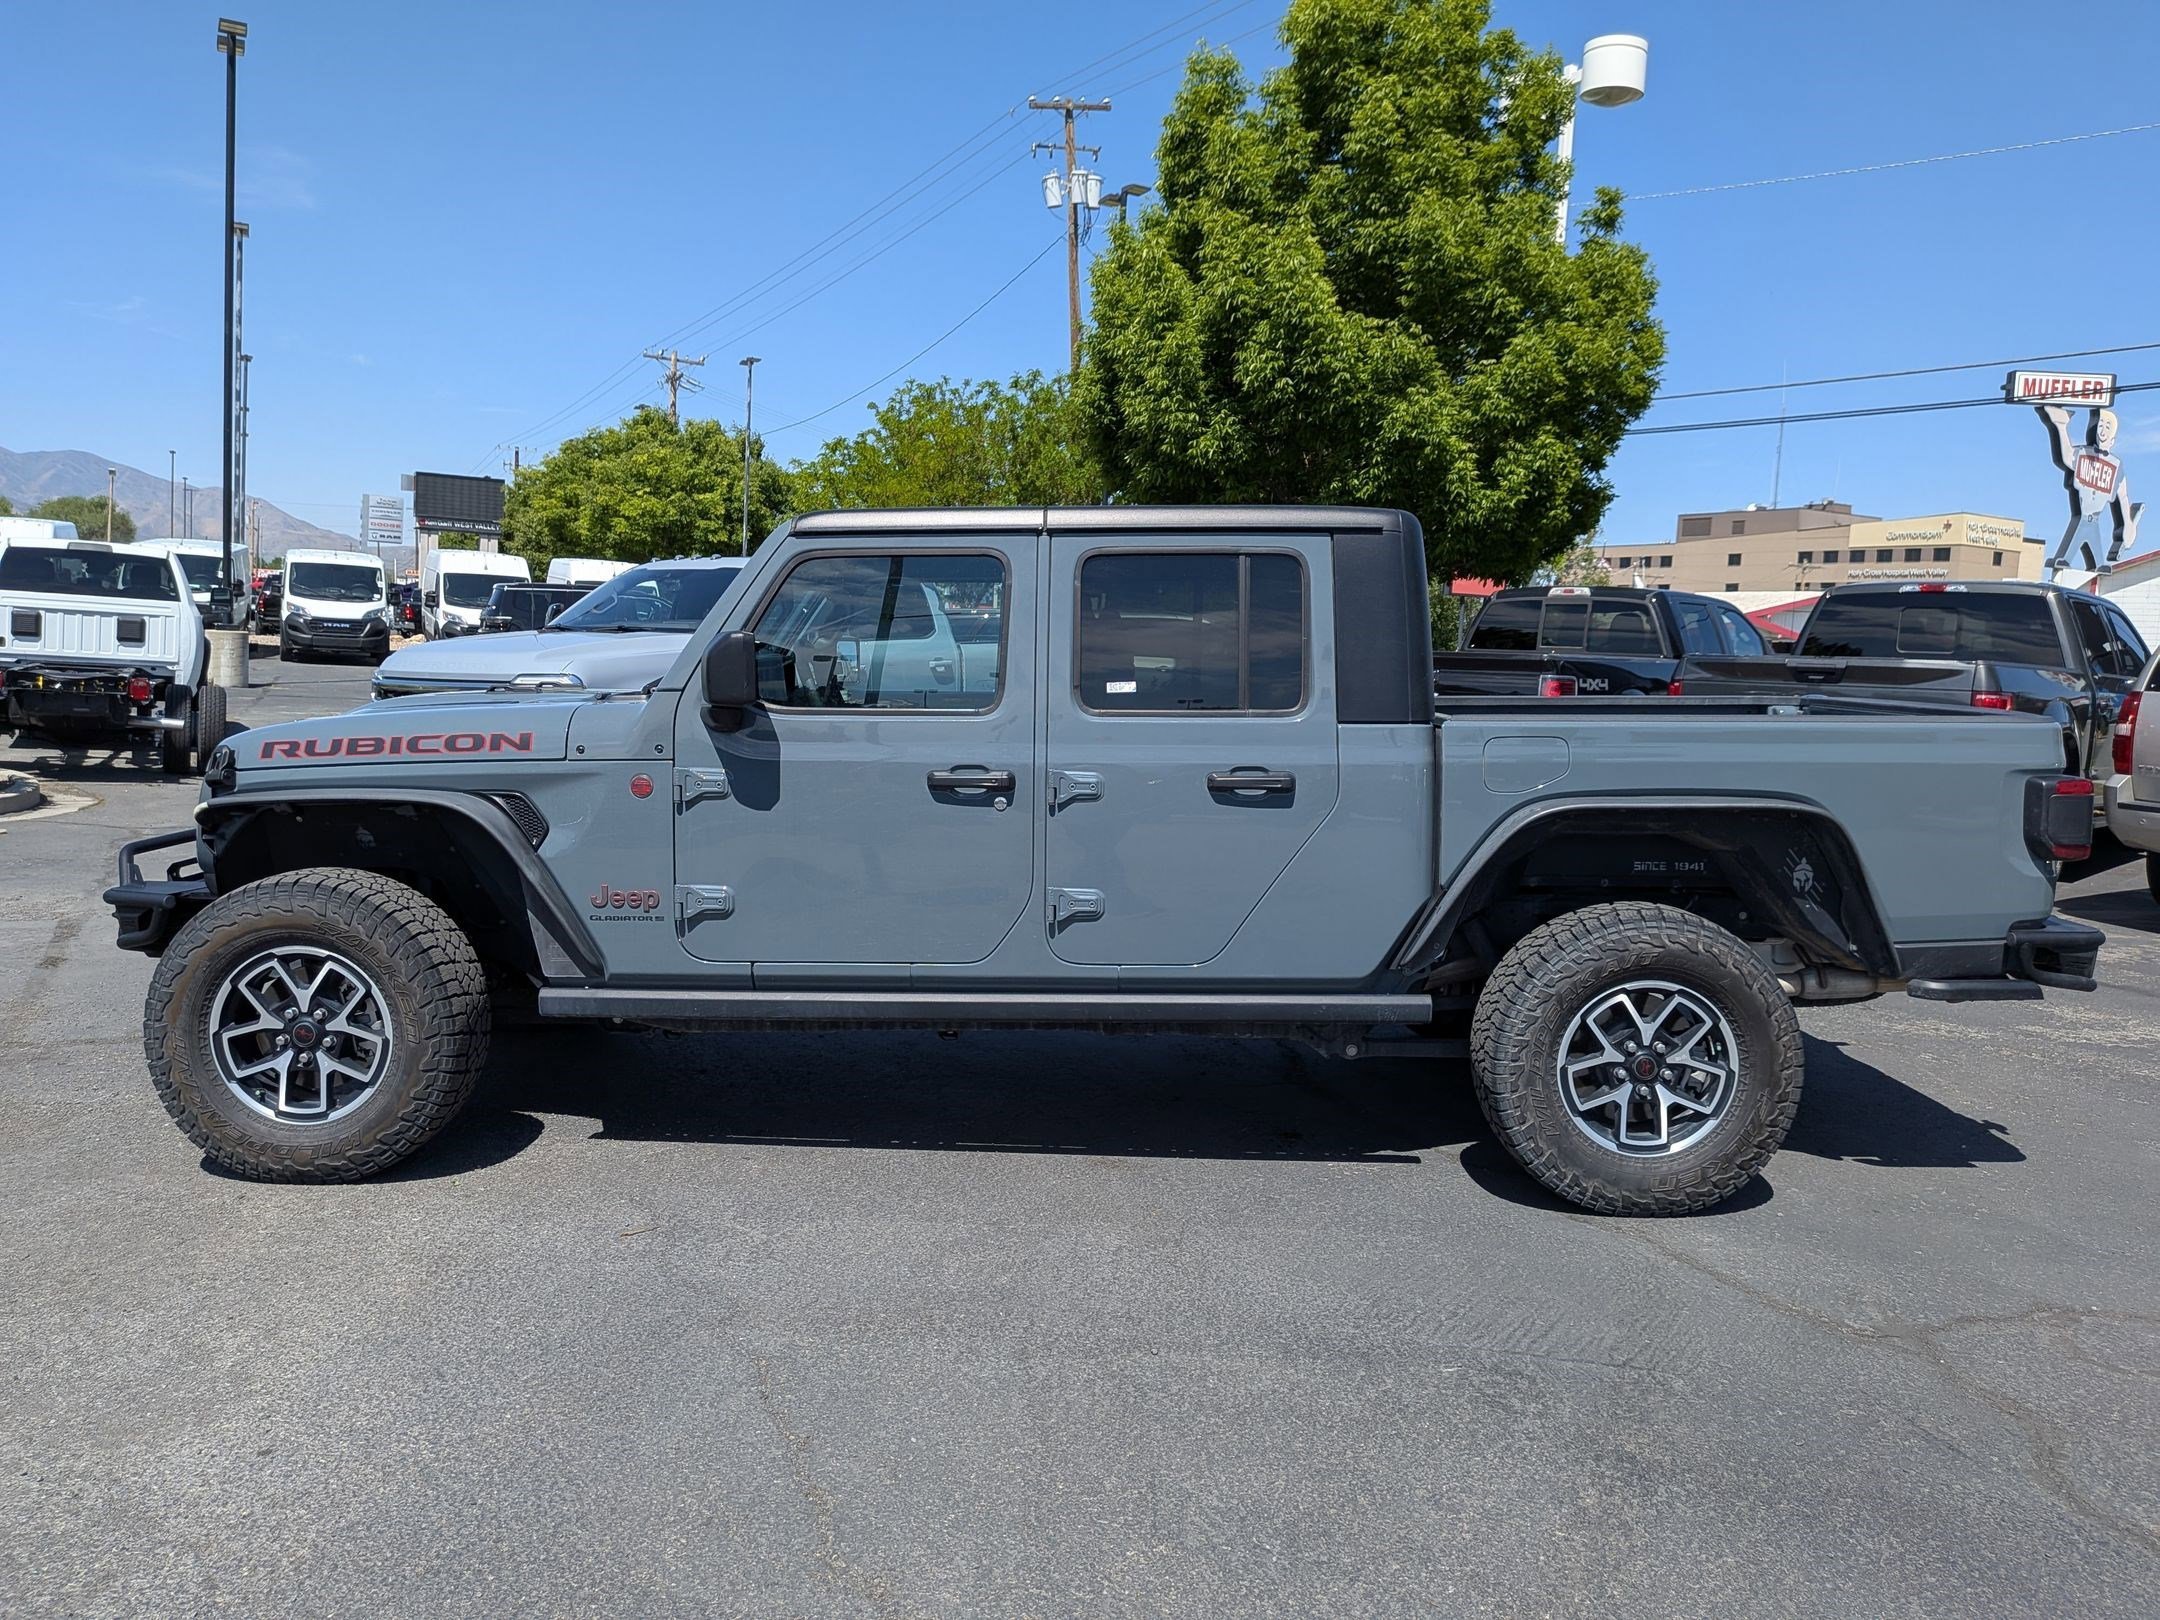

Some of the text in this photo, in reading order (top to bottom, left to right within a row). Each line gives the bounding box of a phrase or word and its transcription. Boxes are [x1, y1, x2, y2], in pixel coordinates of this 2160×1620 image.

[2023, 377, 2104, 400] MUFFLER
[2080, 457, 2113, 490] MUFFLER
[475, 523, 500, 531] VALLEY
[1848, 569, 1862, 578] Holy
[1883, 568, 1908, 578] Hospital
[1909, 567, 1927, 577] West
[1928, 567, 1948, 578] Valley
[260, 732, 533, 759] RUBICON
[1633, 861, 1705, 871] SINCE 1941
[590, 884, 660, 913] Jeep
[1529, 952, 1660, 1136] WILDPEAK A/T
